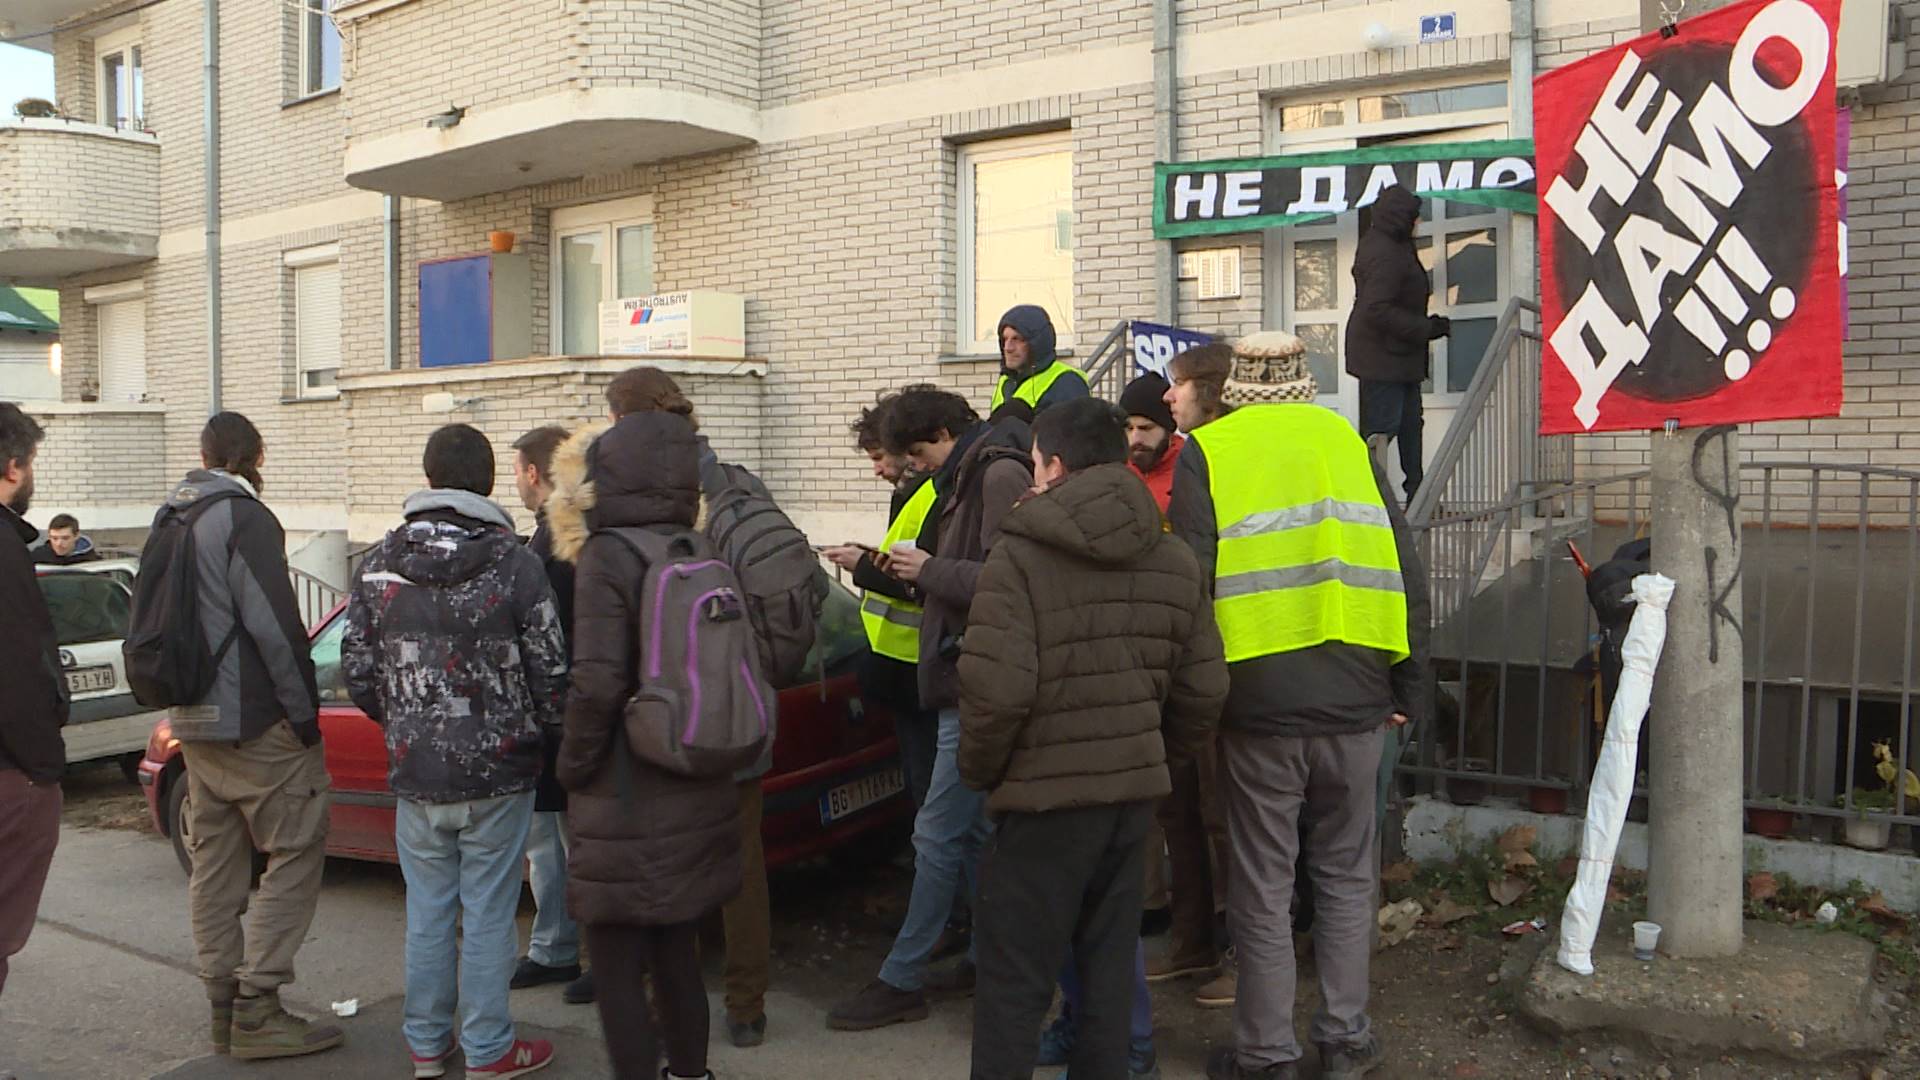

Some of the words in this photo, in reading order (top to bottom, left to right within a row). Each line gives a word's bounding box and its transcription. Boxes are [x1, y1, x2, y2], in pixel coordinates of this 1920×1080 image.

[1174, 171, 1263, 220] НЕ
[1544, 48, 1683, 256] НЕ
[1548, 0, 1830, 430] ДАМО
[624, 294, 687, 310] AUSTROTHERM
